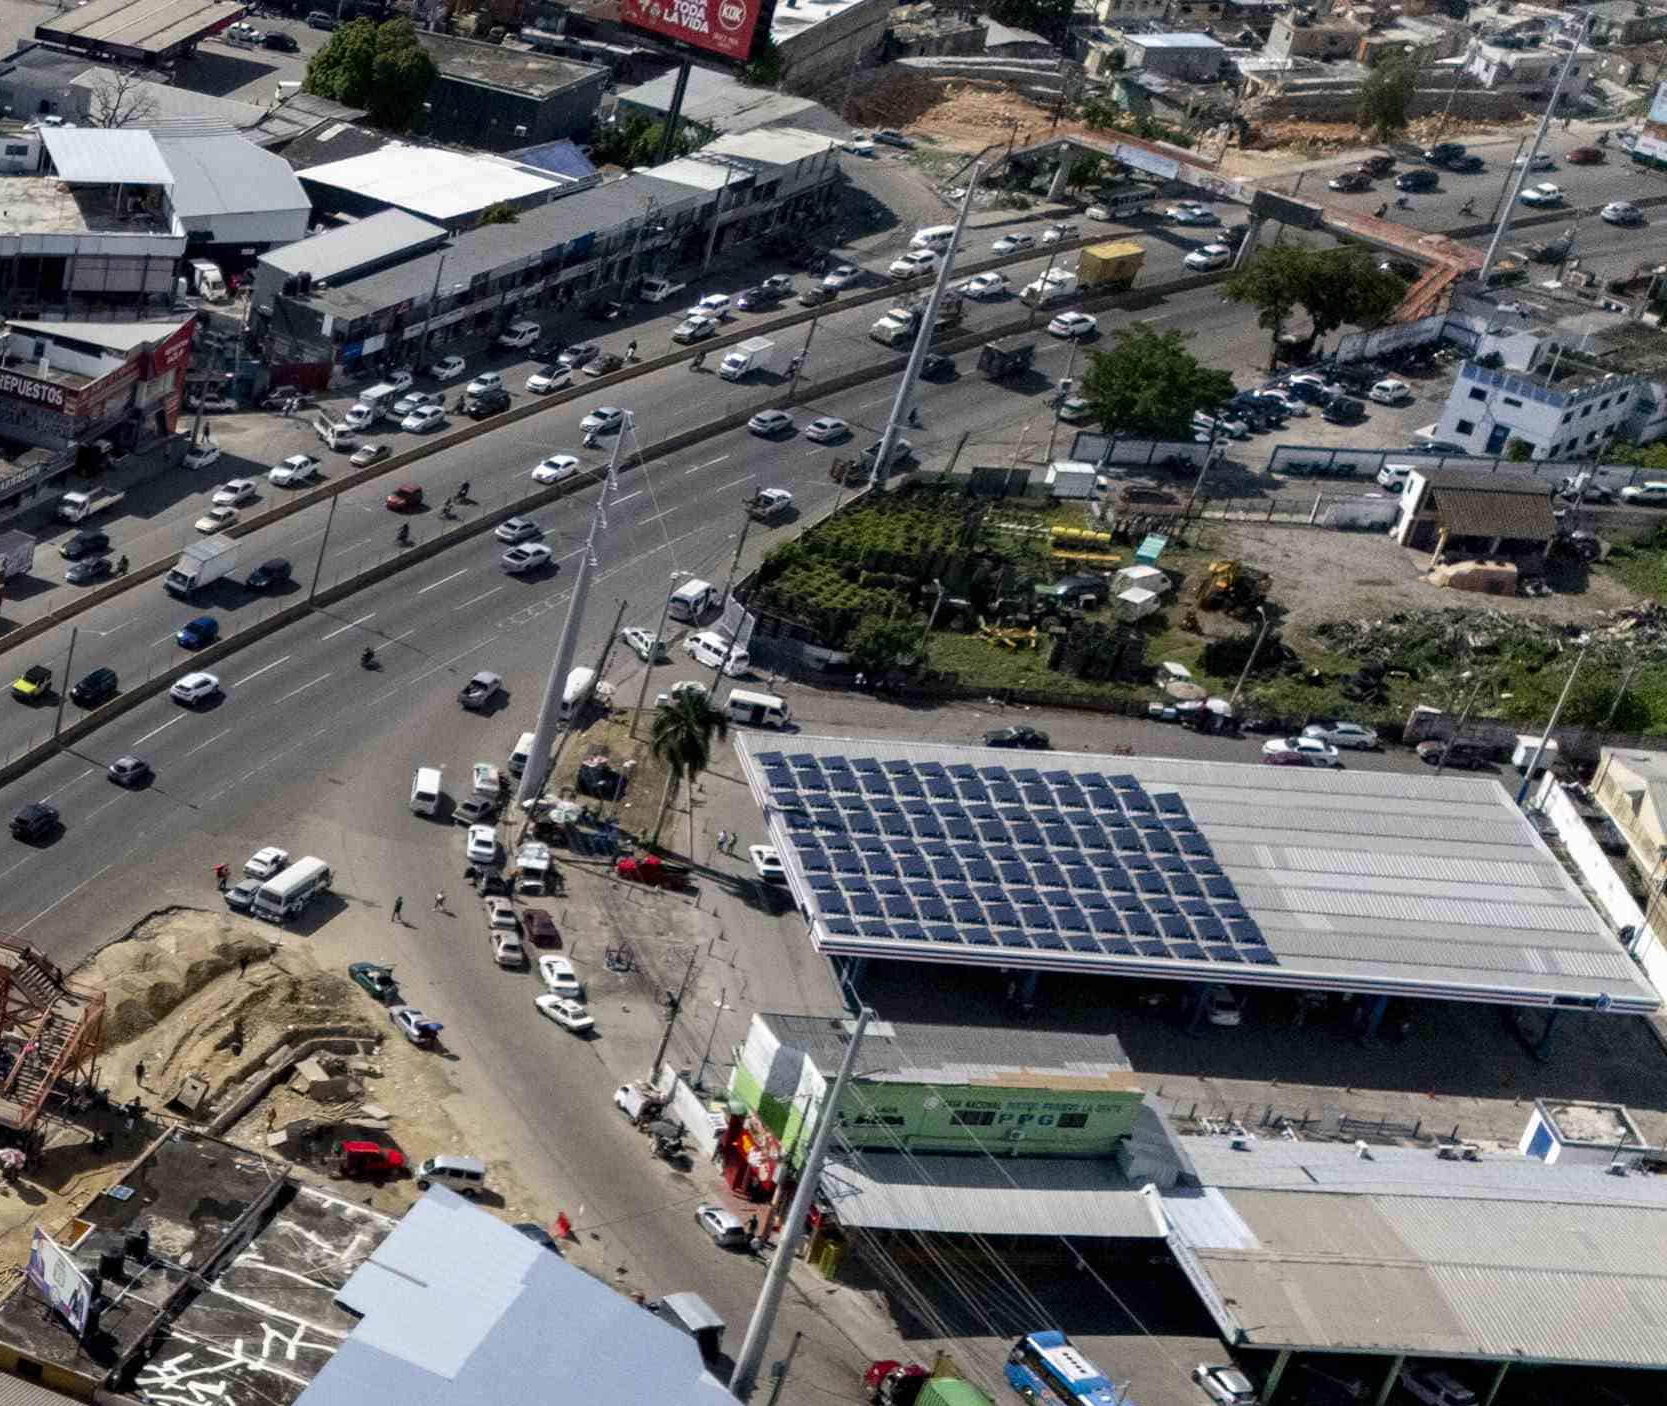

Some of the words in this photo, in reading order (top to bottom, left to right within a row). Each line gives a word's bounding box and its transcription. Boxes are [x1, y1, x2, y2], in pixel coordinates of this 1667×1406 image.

[674, 1, 706, 20] TODA
[663, 8, 679, 24] LA
[681, 16, 709, 33] VIDA
[997, 1113, 1054, 1127] PPG
